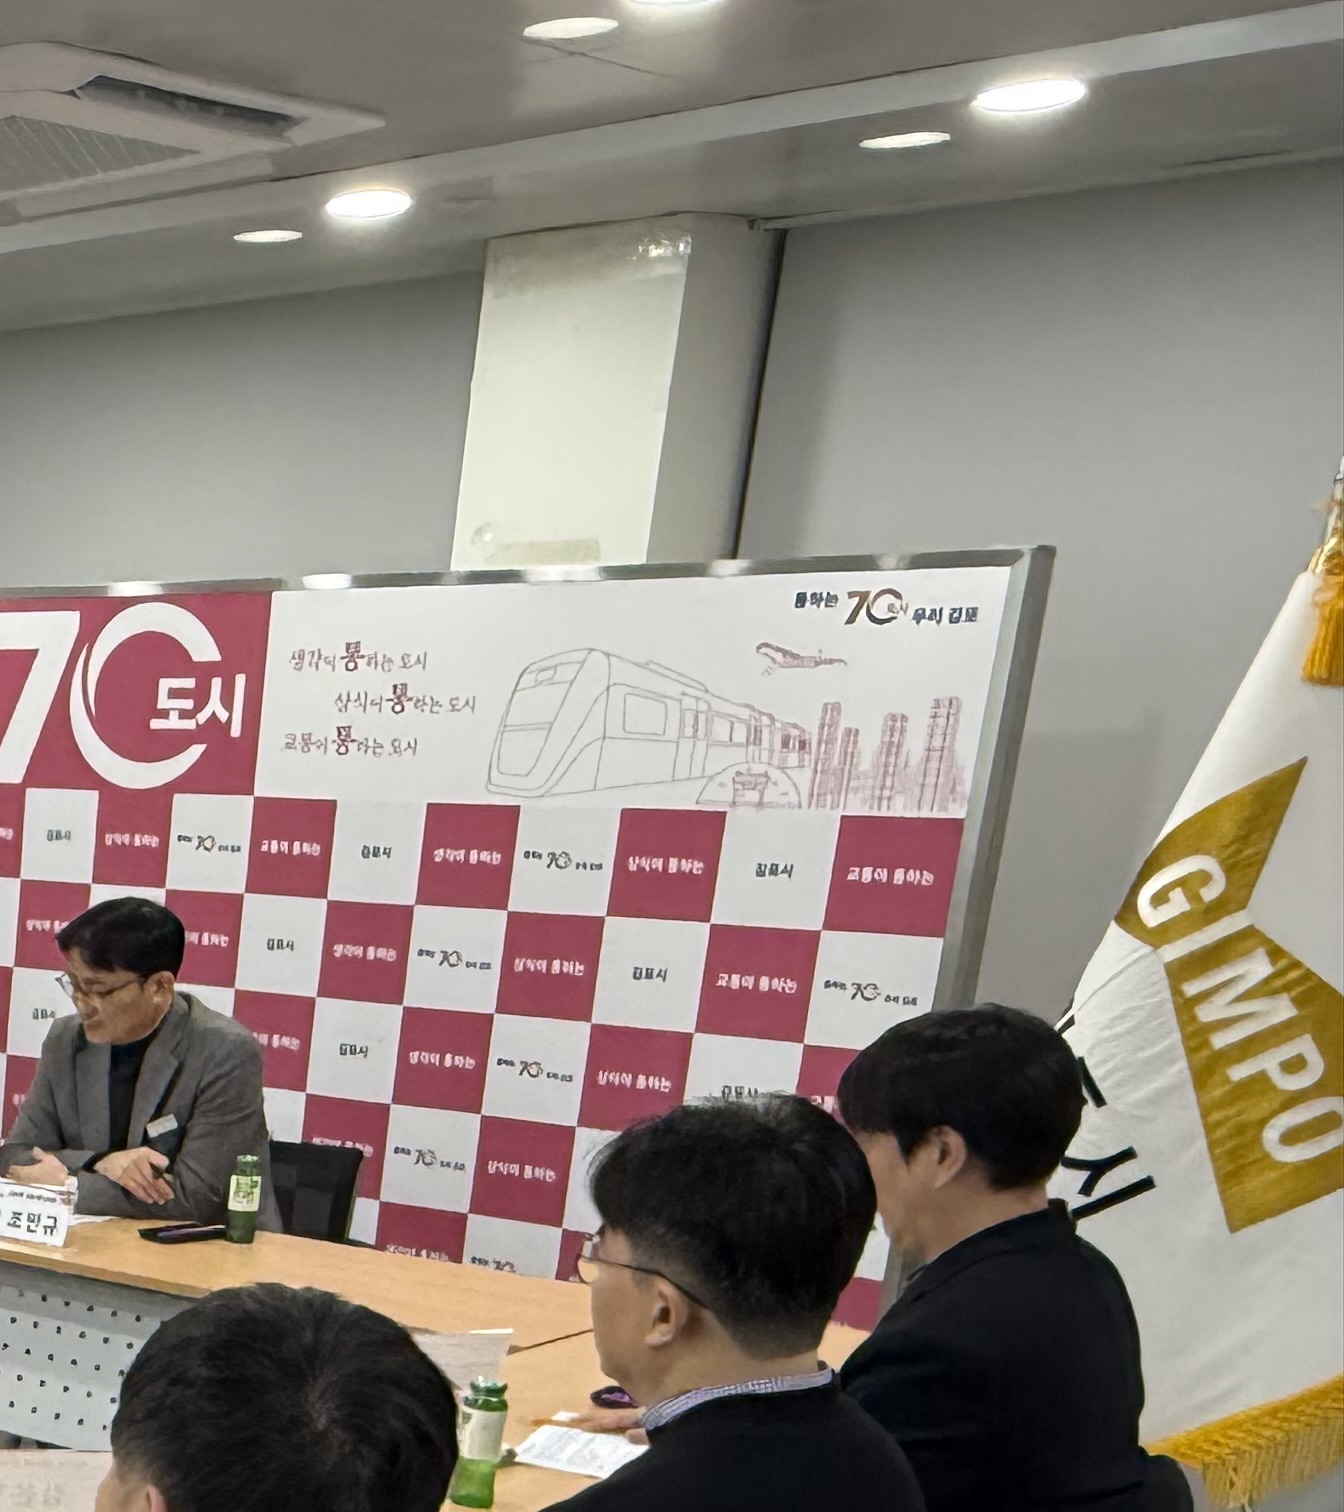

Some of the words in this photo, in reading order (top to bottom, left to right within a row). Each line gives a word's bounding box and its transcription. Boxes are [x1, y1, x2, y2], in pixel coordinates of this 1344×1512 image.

[400, 651, 428, 672] 도시
[149, 673, 247, 738] 도시
[447, 695, 476, 713] 도시
[755, 862, 794, 881] 김포시
[633, 966, 669, 983] 김포시
[1137, 854, 1344, 1163] GIMPO
[7, 1211, 58, 1236] 조민규
